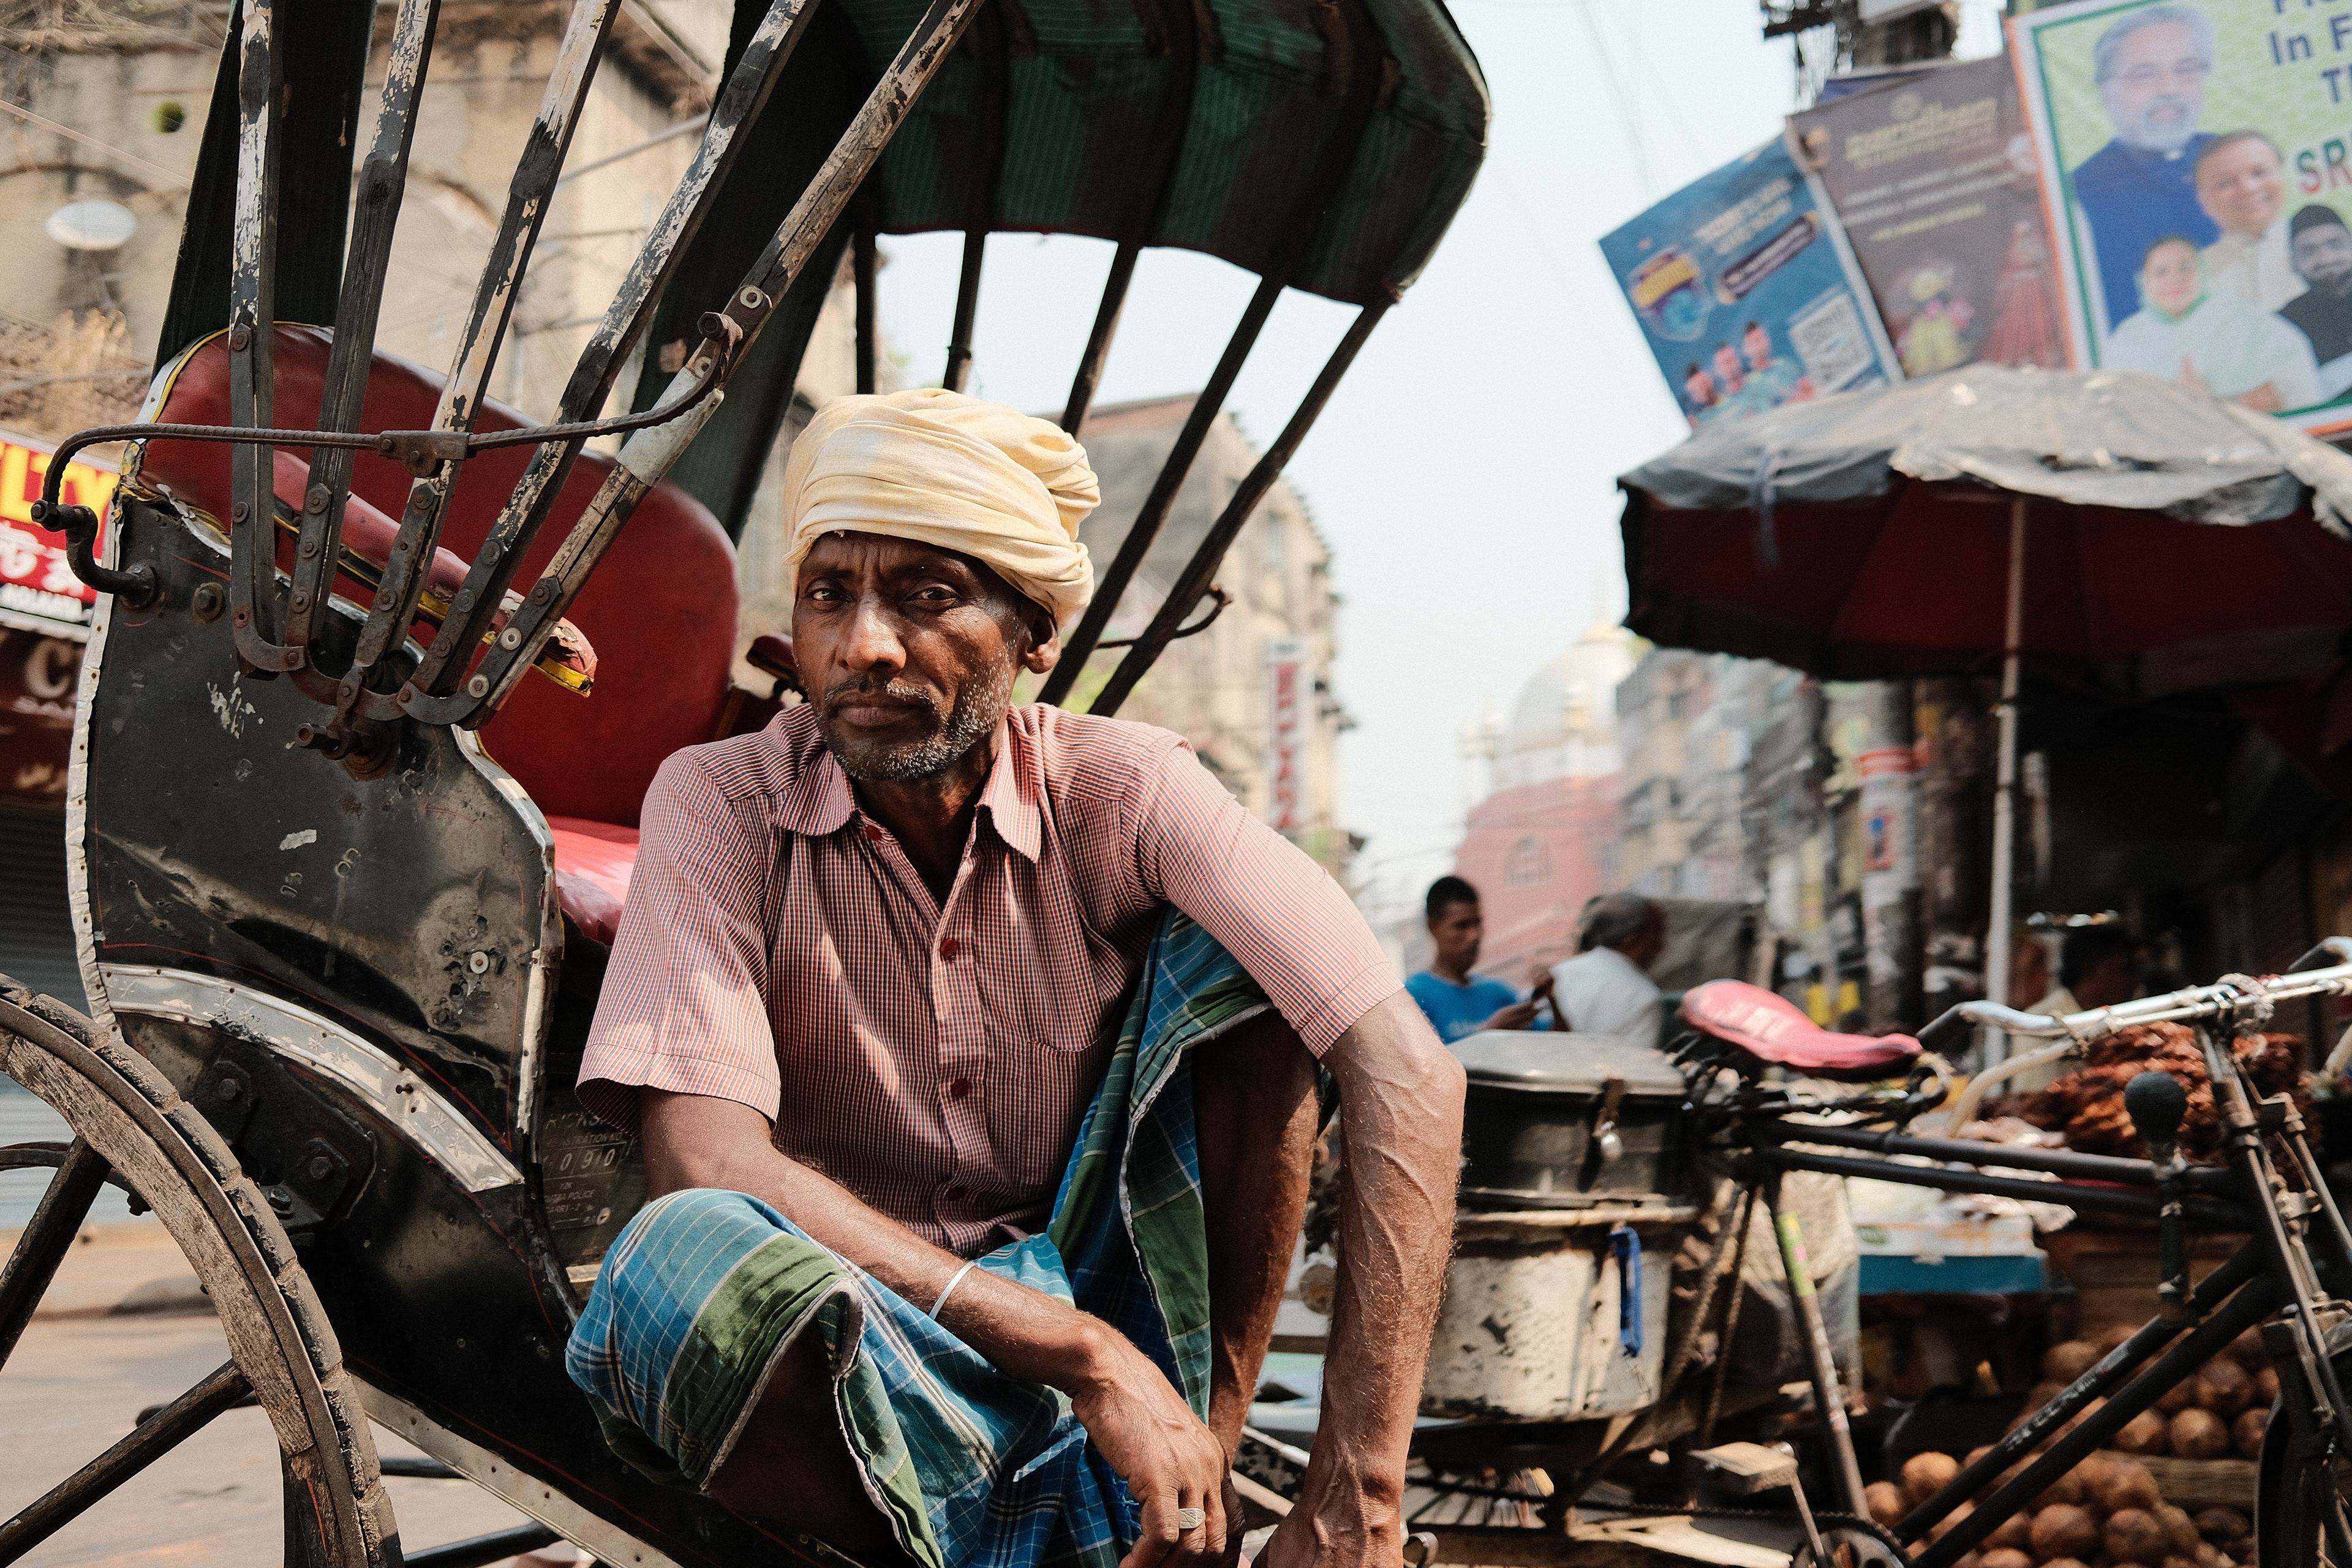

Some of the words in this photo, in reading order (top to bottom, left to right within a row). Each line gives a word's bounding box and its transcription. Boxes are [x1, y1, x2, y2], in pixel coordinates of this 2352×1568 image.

[2268, 29, 2312, 66] In
[2320, 62, 2352, 104] T
[0, 440, 120, 539] LTY
